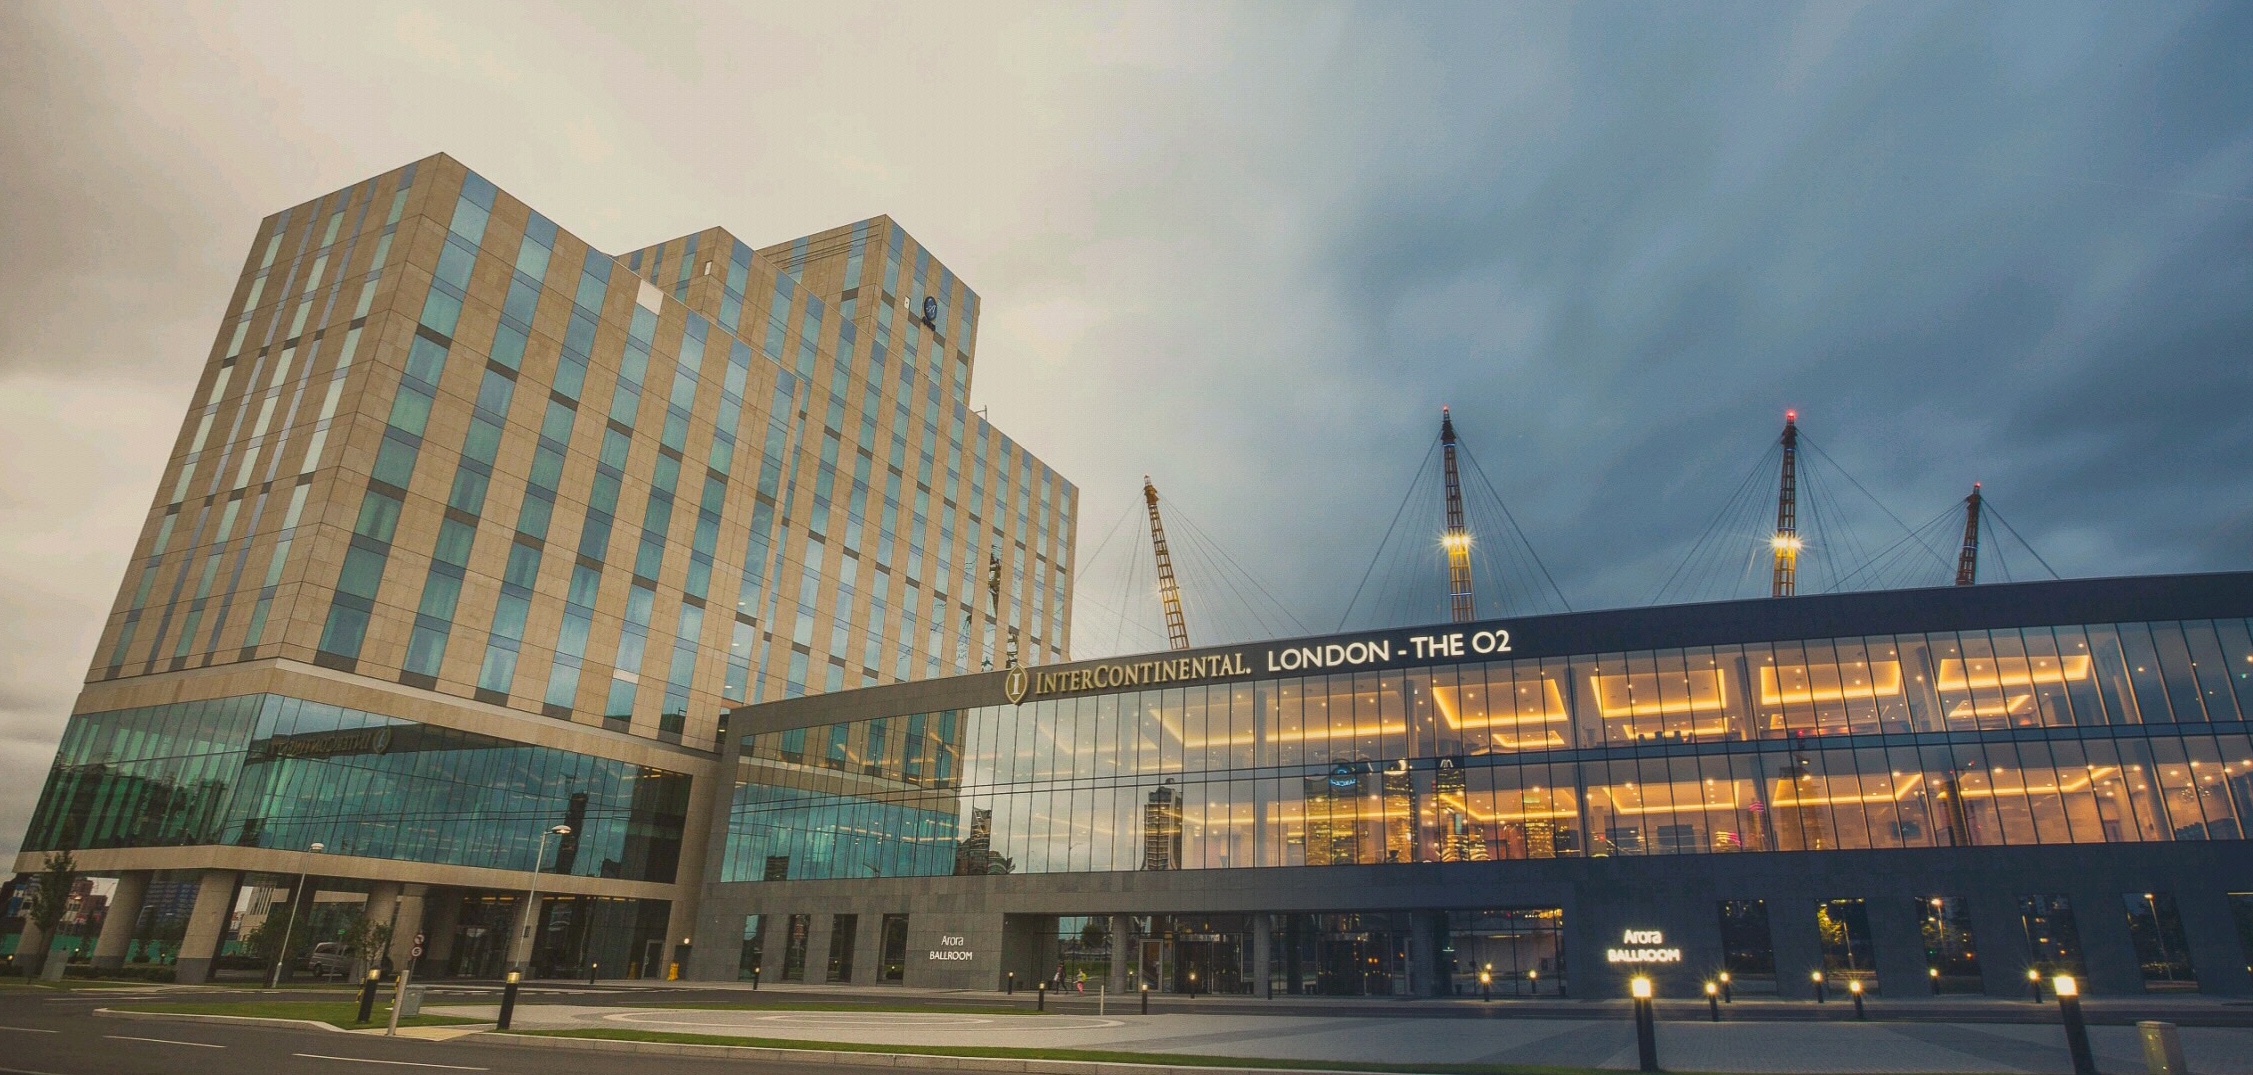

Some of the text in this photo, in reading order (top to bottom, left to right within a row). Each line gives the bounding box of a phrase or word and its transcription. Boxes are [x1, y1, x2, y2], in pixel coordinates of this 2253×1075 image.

[1268, 640, 1390, 672] LONDON
[1410, 633, 1465, 659] THE
[1472, 630, 1512, 653] O2
[941, 935, 964, 946] Arora
[1623, 929, 1663, 944] Arora
[929, 951, 973, 960] BALLROOM
[1607, 949, 1681, 962] BALLROOM
